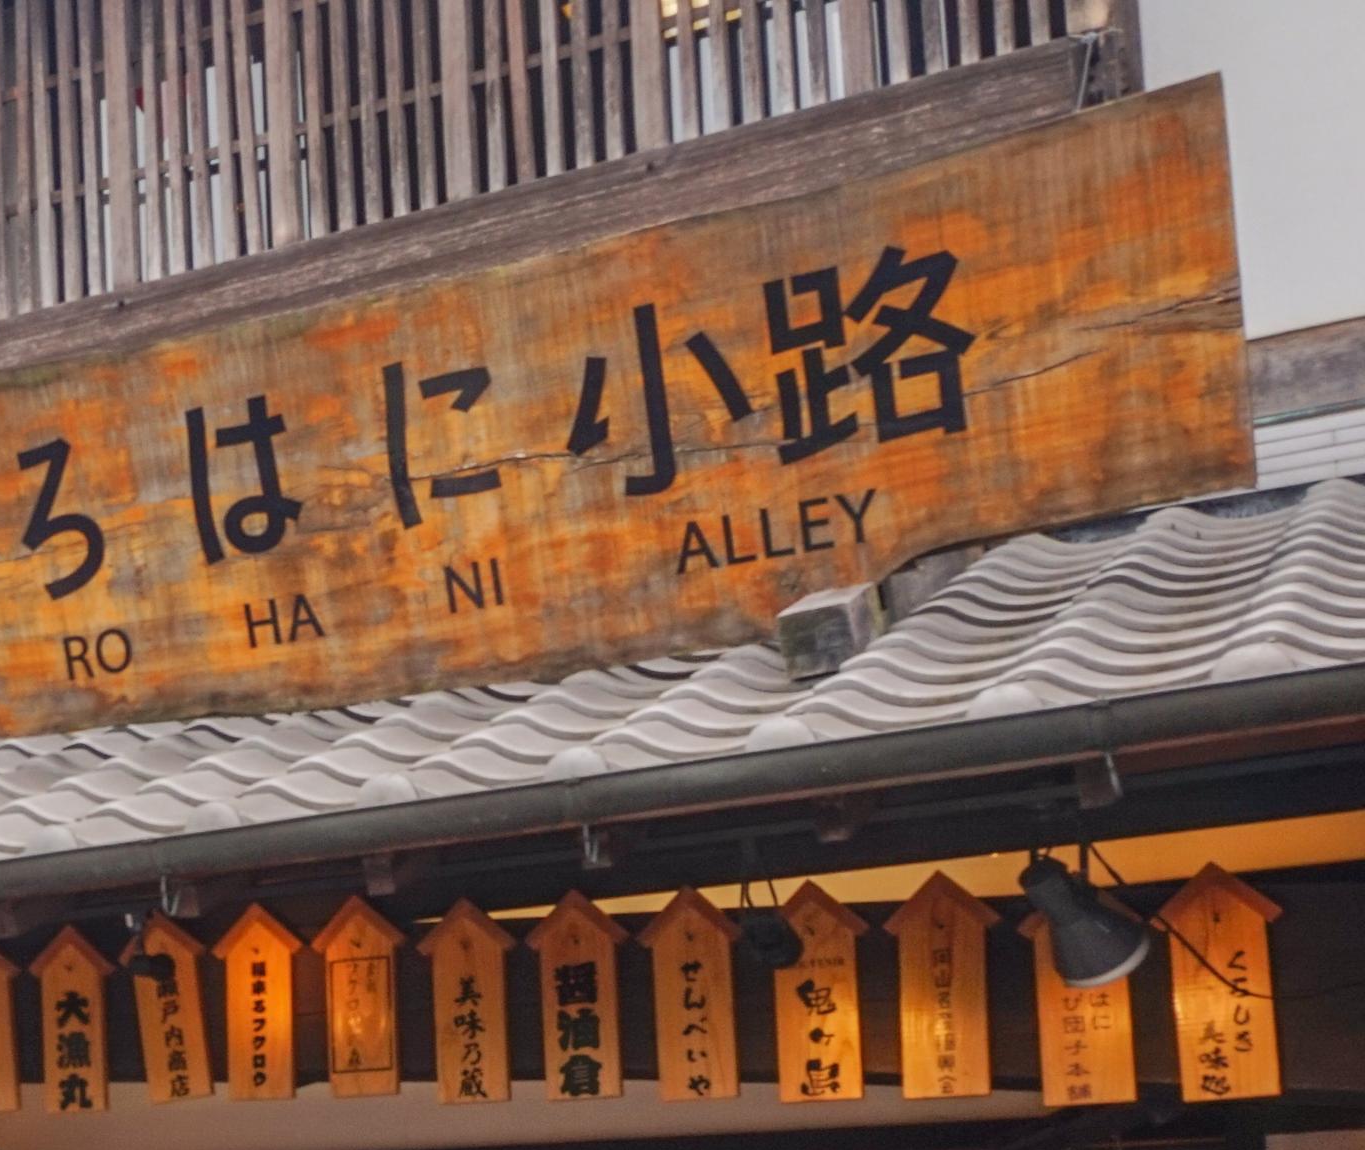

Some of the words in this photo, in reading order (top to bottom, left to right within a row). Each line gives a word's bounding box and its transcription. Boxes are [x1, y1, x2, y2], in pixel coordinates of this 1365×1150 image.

[64, 627, 134, 678] RO
[244, 590, 324, 650] HA
[444, 561, 505, 612] NI
[675, 490, 876, 573] ALLEY
[55, 991, 92, 1110] 大漁丸
[453, 976, 489, 1099] 美味乃蔵
[679, 961, 712, 1097] せんべいや
